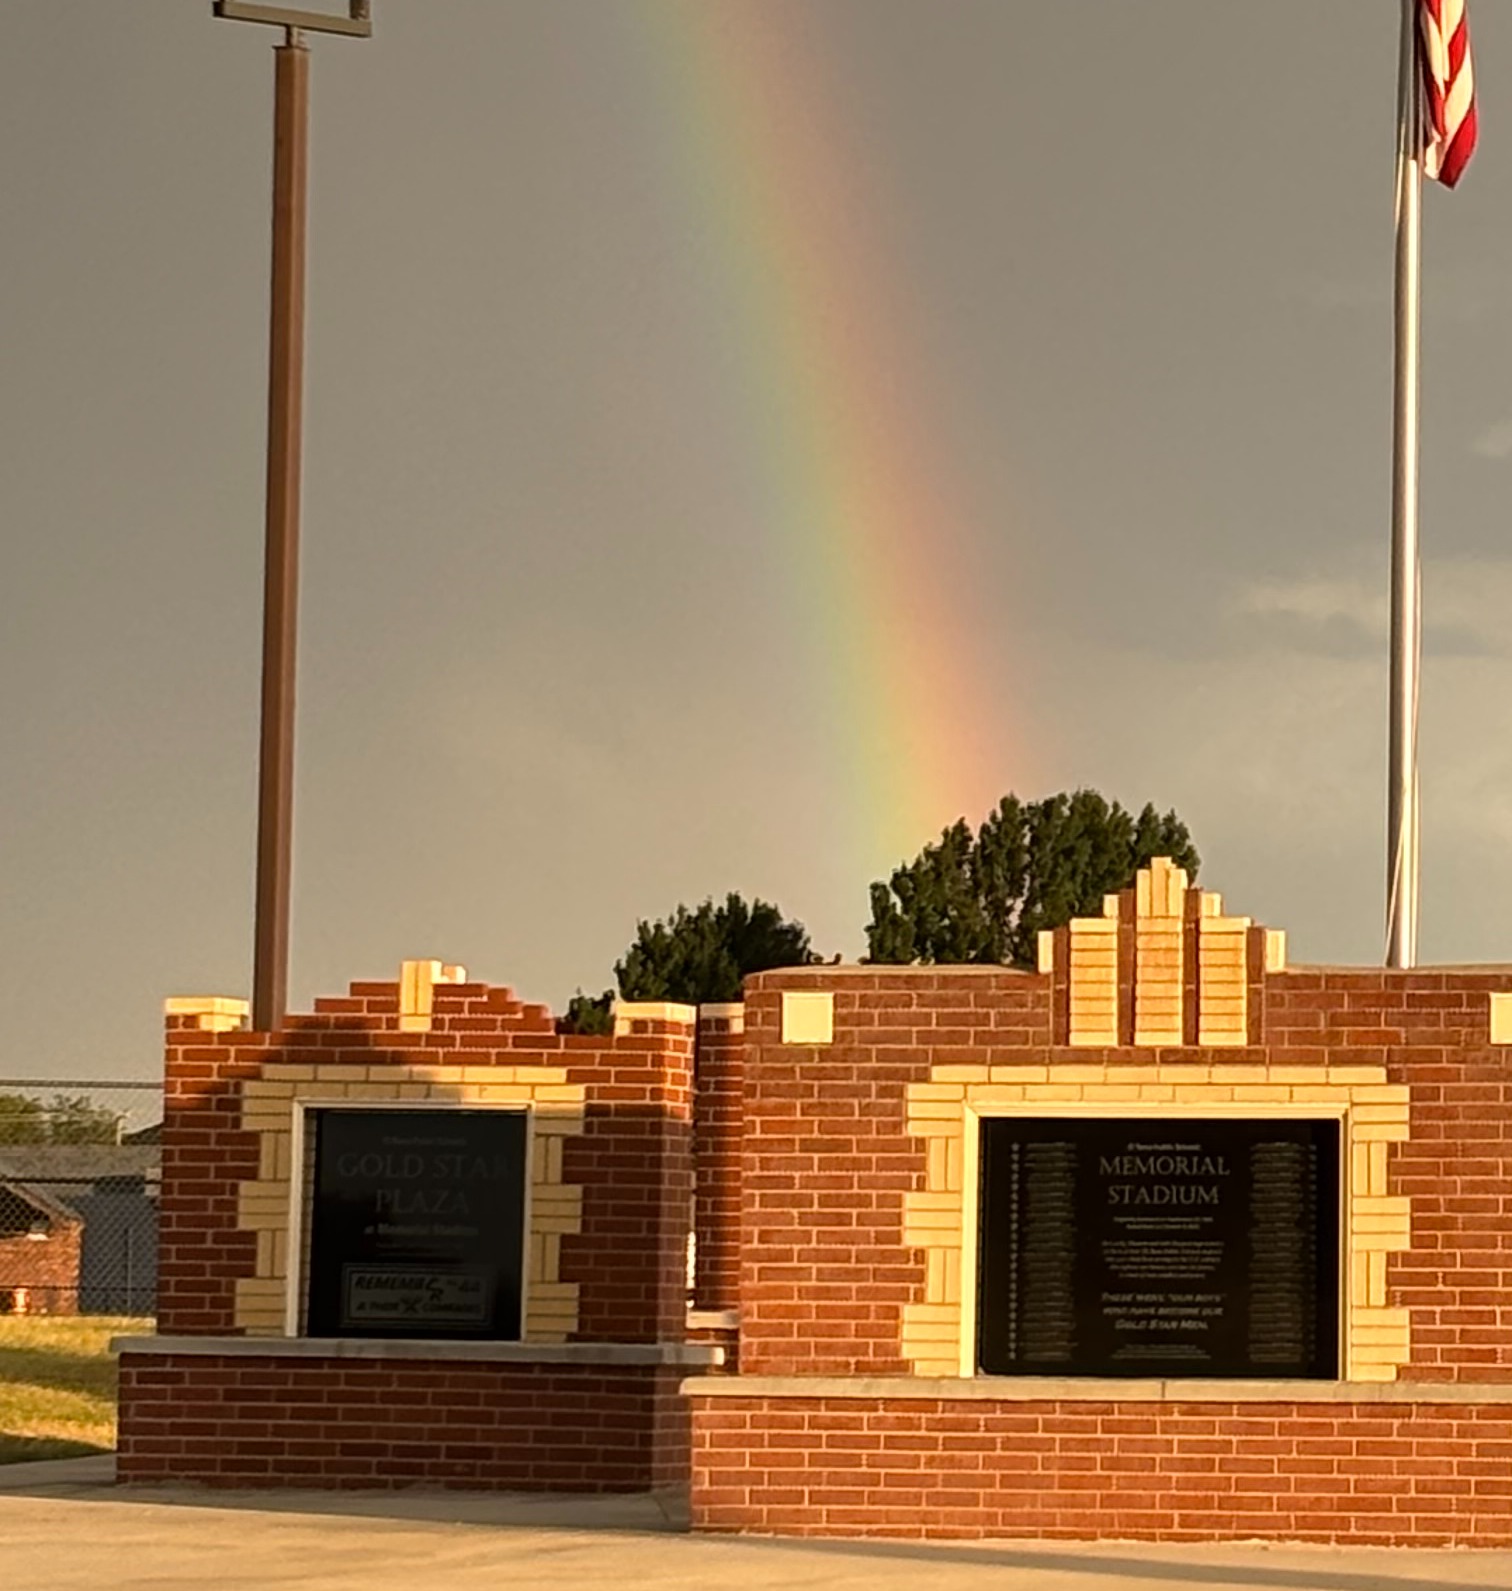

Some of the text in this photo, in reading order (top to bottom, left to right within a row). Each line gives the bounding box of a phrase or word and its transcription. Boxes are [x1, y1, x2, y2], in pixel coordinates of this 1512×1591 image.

[336, 1152, 425, 1179] GOLD
[1099, 1154, 1231, 1176] MEMORIAL
[375, 1188, 470, 1214] PLAZA
[1107, 1183, 1220, 1205] STADIUM
